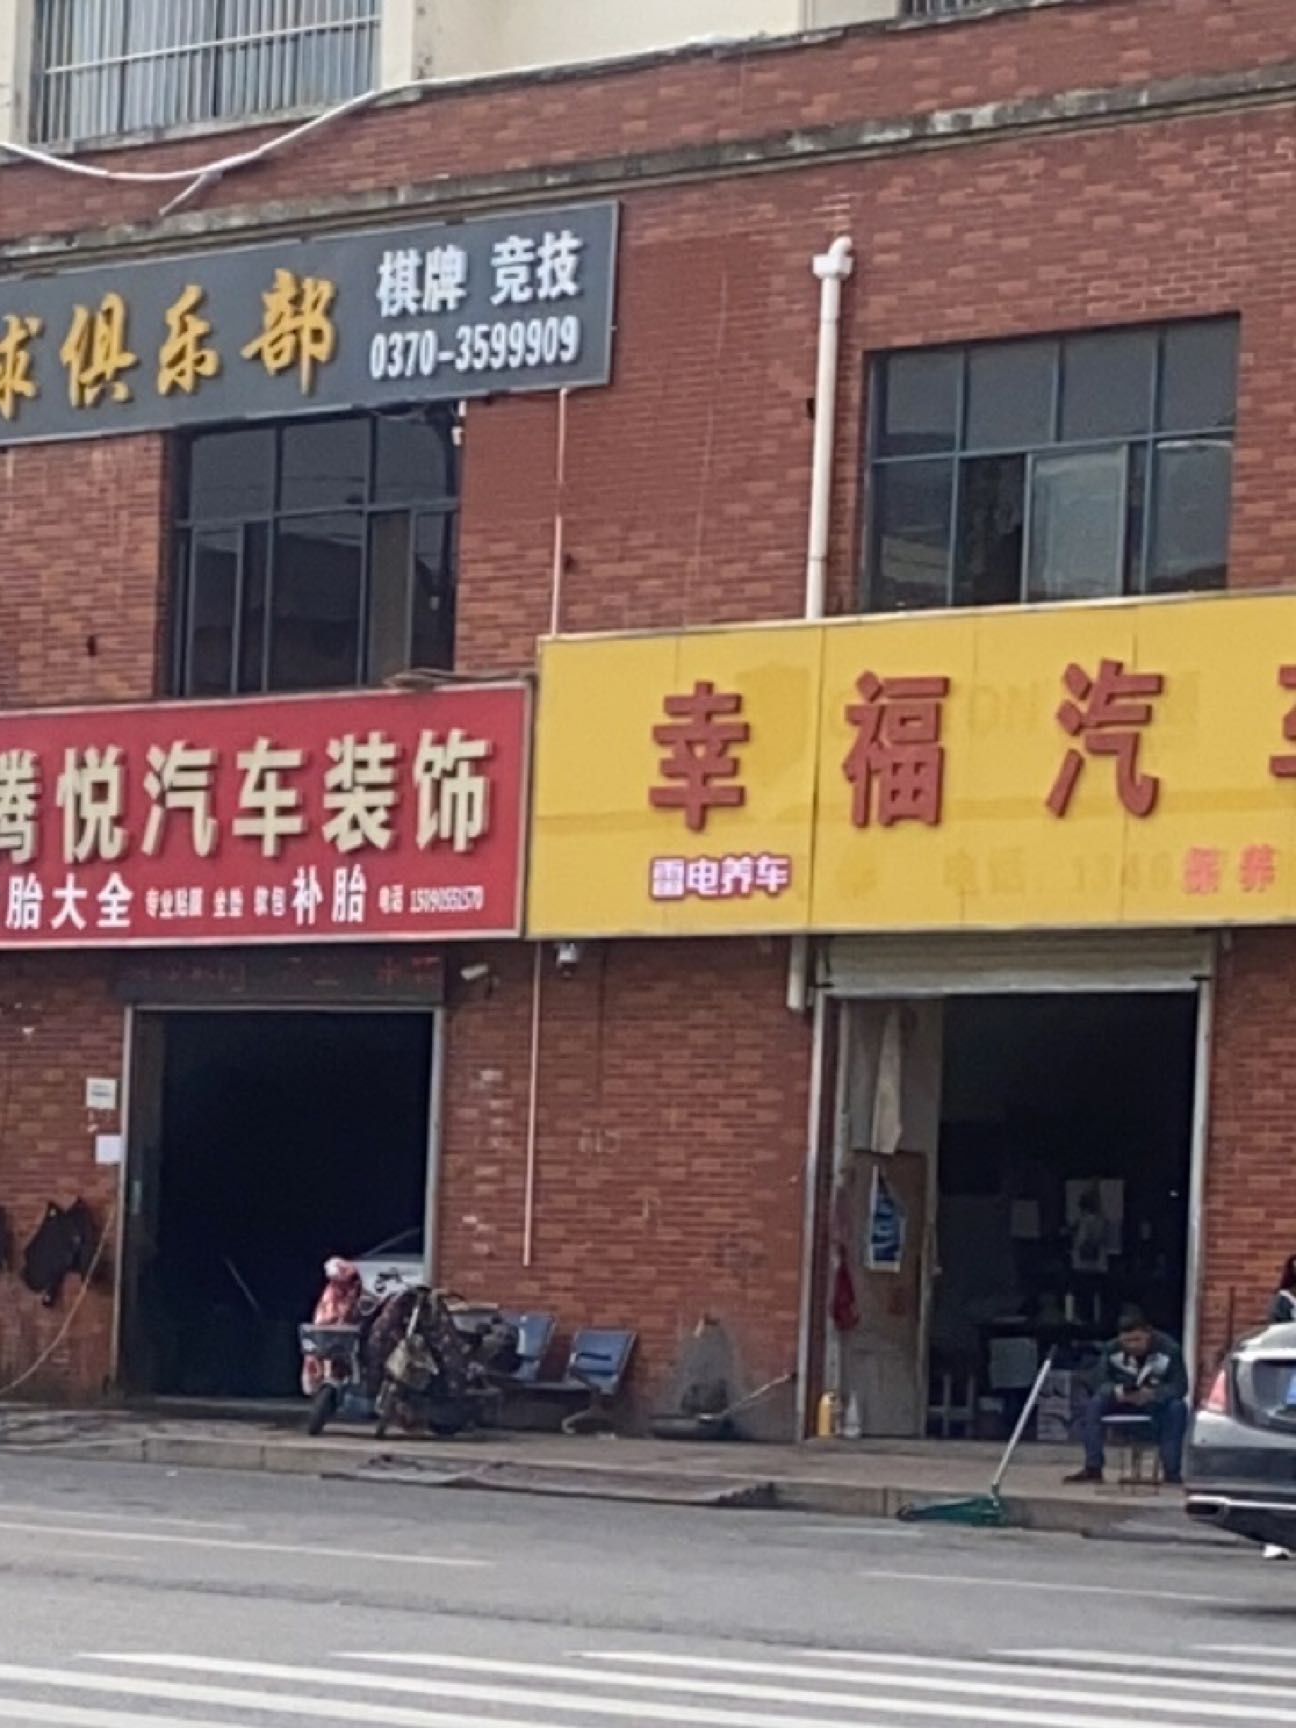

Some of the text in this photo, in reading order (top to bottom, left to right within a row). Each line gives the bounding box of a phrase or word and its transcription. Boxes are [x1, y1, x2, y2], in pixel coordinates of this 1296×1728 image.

[376, 230, 581, 318] 棋牌 竞技
[369, 315, 580, 380] 0370-3599909
[648, 659, 1296, 832] 幸福汽
[292, 864, 367, 925] 补胎
[652, 855, 789, 896] 雷电养车
